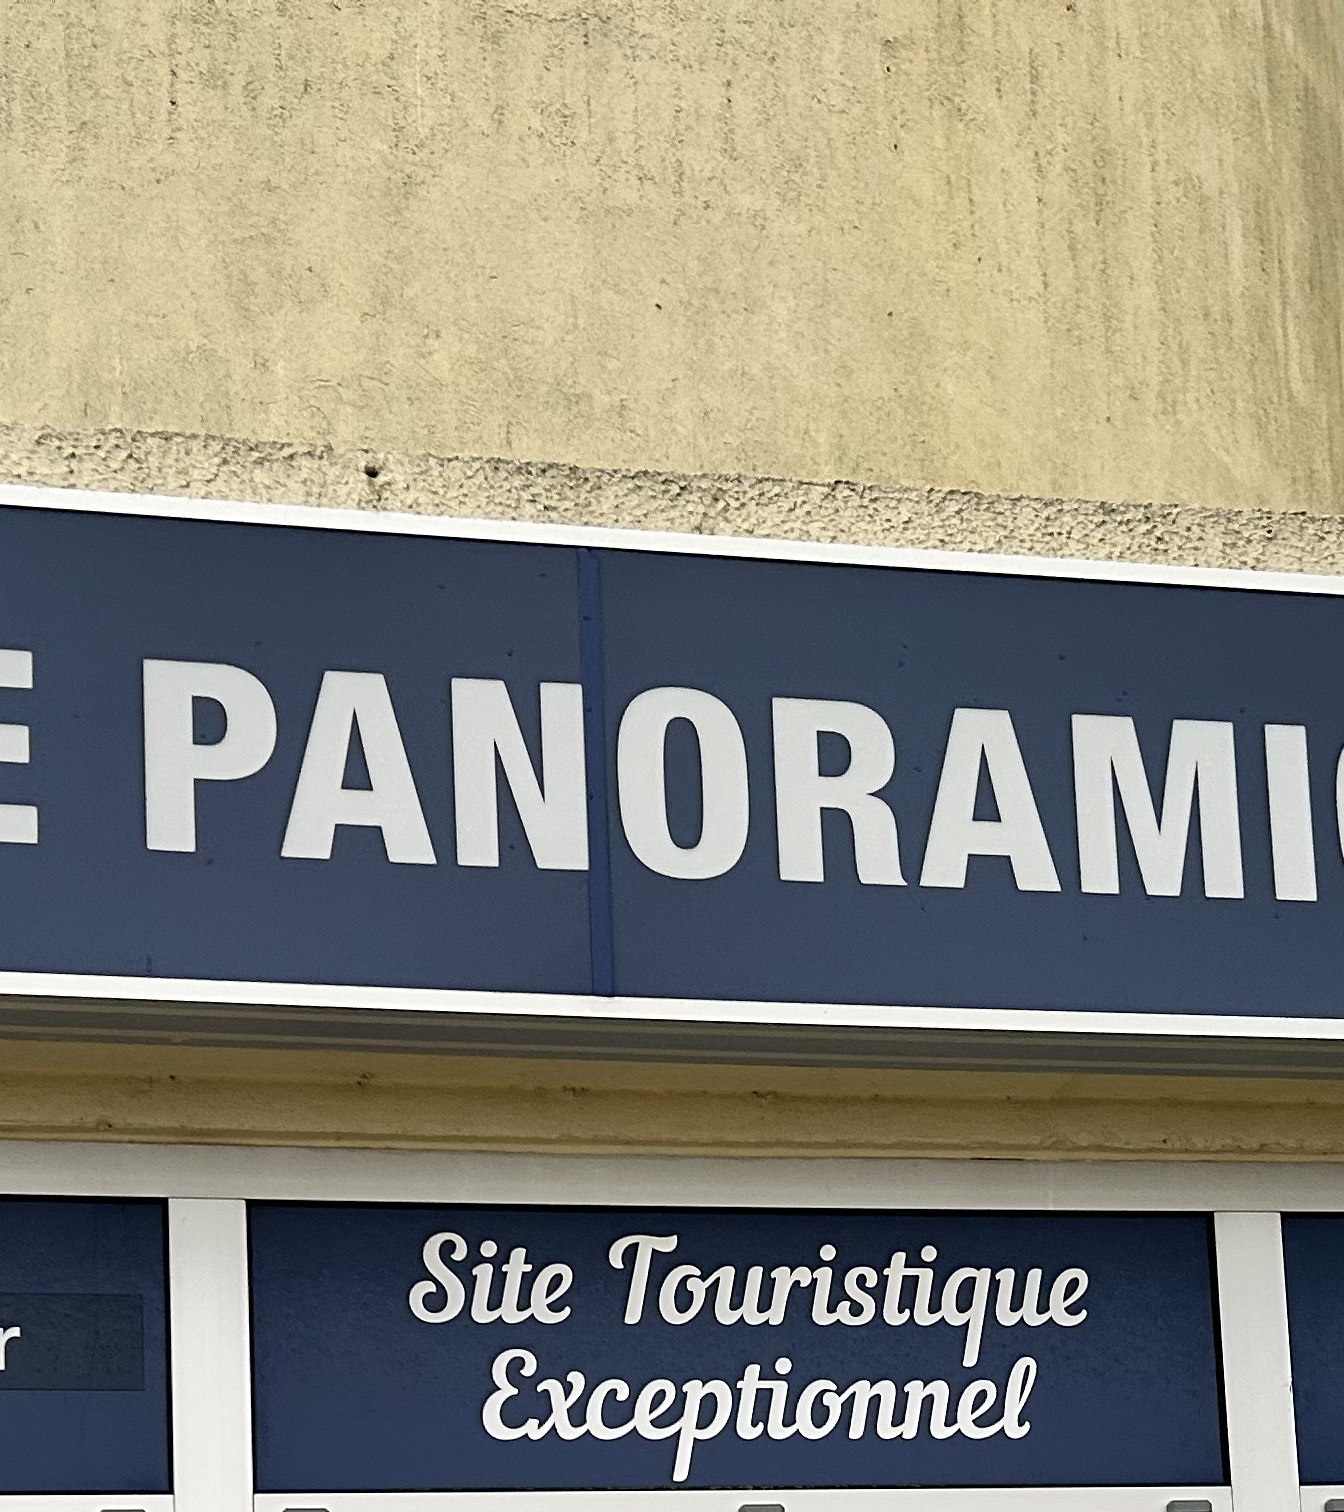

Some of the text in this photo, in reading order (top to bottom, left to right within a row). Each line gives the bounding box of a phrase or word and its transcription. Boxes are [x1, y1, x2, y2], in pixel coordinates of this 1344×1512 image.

[408, 1232, 1089, 1367] Site Touristique
[481, 1348, 1038, 1482] Exceptionnel
